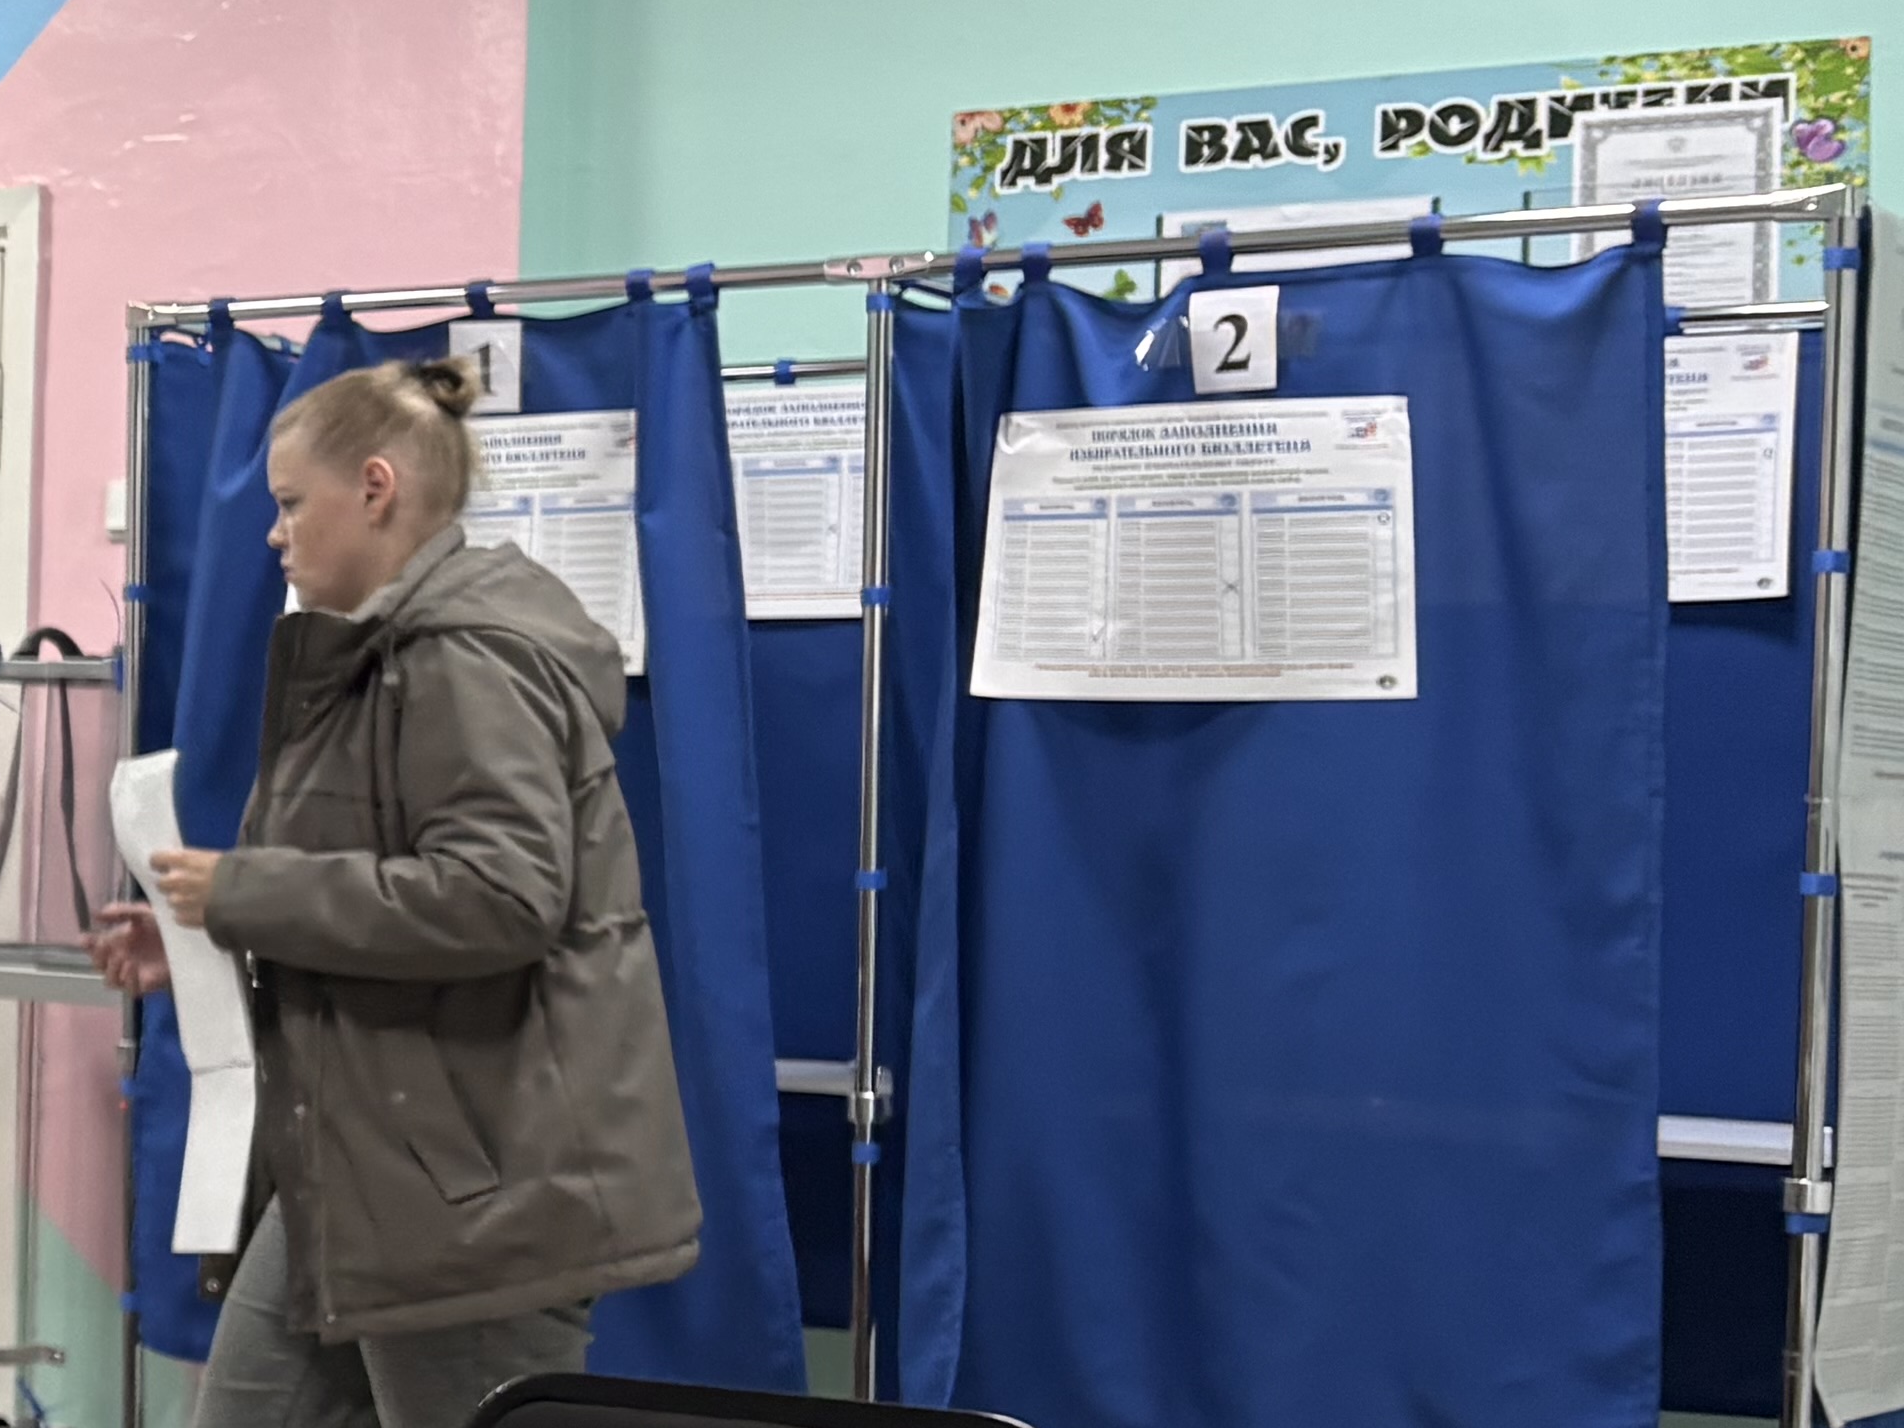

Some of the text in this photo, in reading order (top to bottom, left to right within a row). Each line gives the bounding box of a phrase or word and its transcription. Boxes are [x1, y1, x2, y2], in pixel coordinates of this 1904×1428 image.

[999, 79, 1791, 187] ДЛЯ ВАС, РОДИ
[1213, 313, 1252, 374] 2
